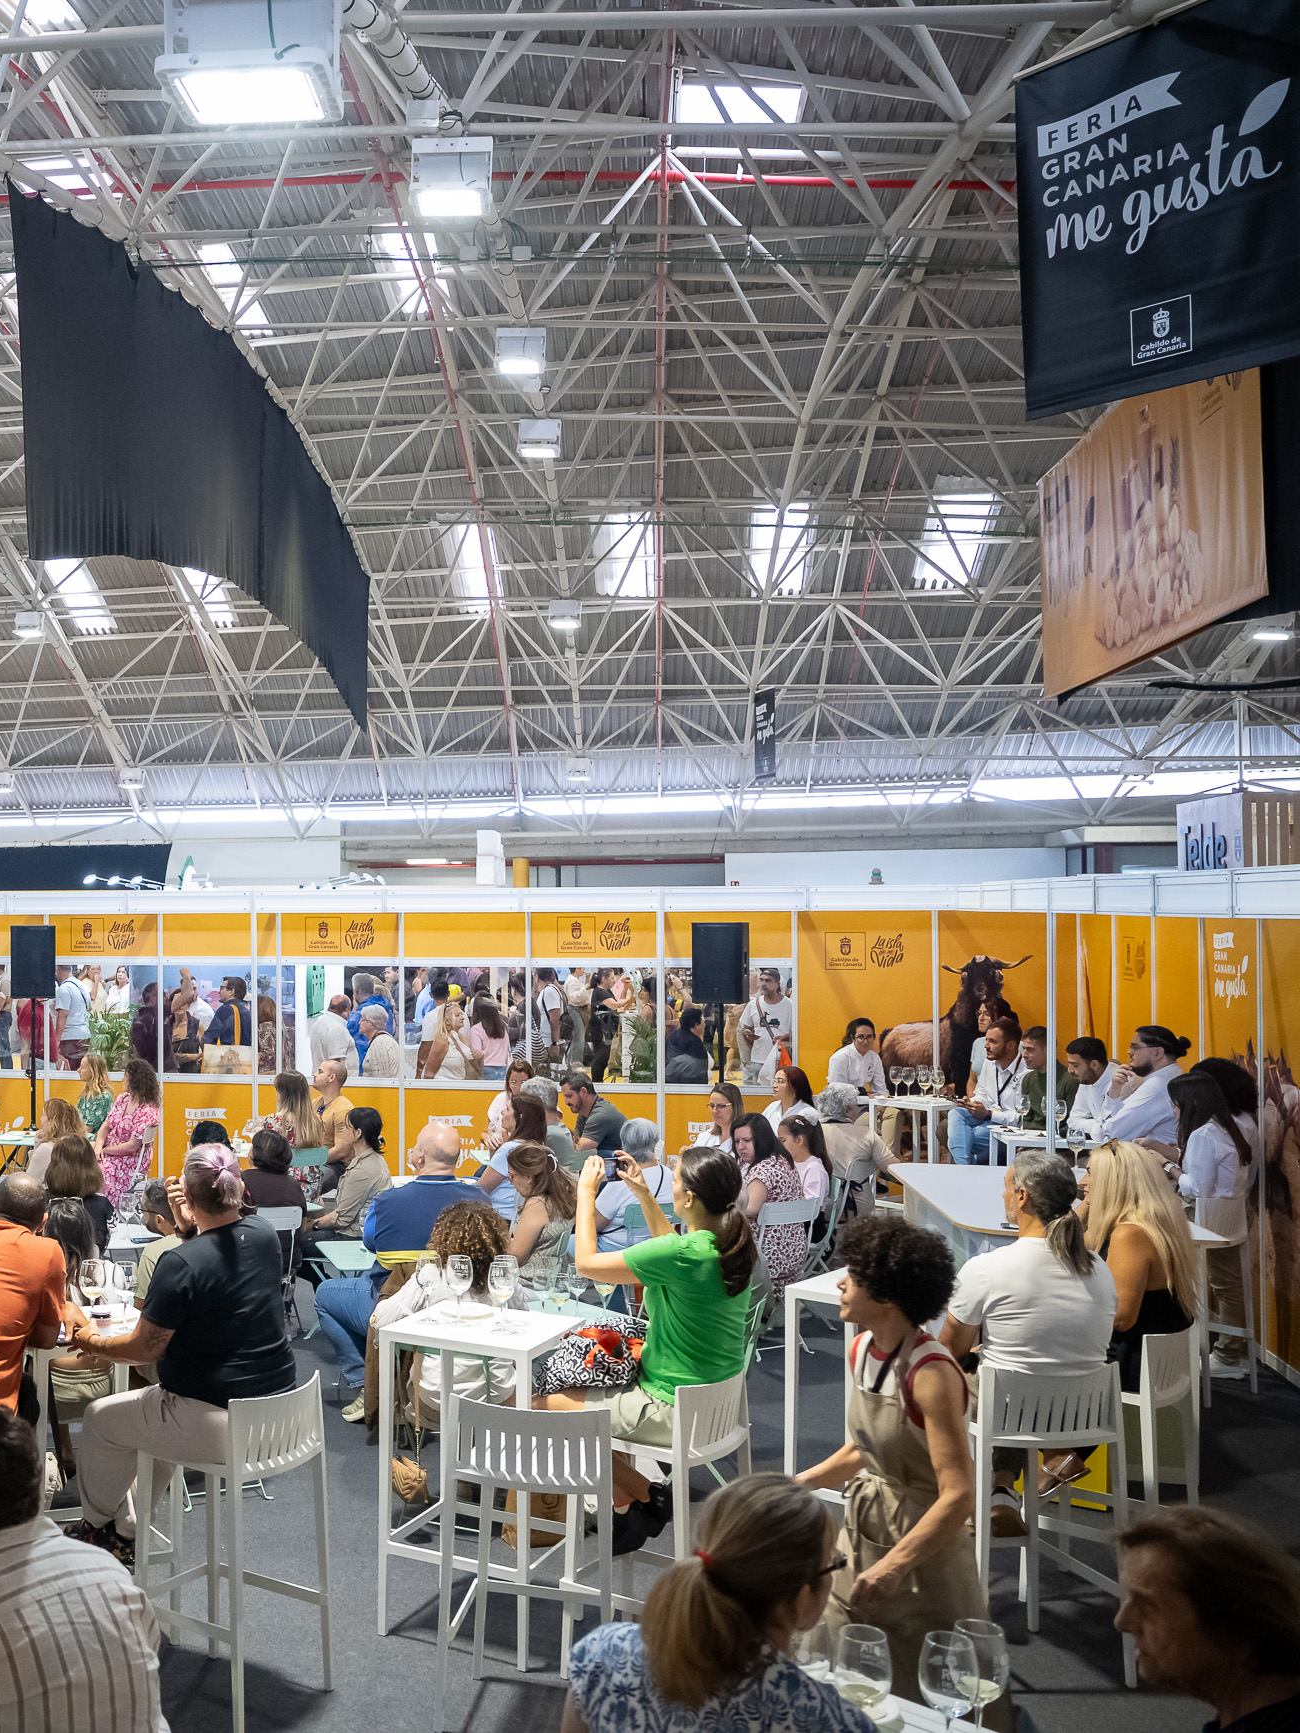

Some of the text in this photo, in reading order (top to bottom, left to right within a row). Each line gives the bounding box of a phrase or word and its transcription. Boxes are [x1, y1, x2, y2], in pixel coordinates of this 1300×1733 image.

[1046, 95, 1143, 150] FERIA
[1042, 133, 1128, 180] GRAN
[1042, 142, 1190, 207] CANARIA
[1046, 124, 1282, 259] me gusta
[1137, 342, 1187, 359] Gran Canaria
[1140, 336, 1182, 352] Cabildo de
[1180, 822, 1227, 871] Telde
[108, 918, 135, 936] La isla
[345, 917, 375, 936] La isla
[600, 917, 631, 936] La isla
[108, 933, 135, 950] Vida
[345, 933, 374, 951] Vida
[600, 933, 631, 951] Vida
[871, 933, 904, 952] La isla
[1215, 936, 1229, 947] FERIA
[870, 949, 904, 968] Vida
[1214, 950, 1228, 961] GRAN
[1214, 963, 1236, 974] CANARIA
[1214, 964, 1248, 1009] me gusta
[188, 1110, 217, 1118] FERIA
[691, 1124, 711, 1132] FER
